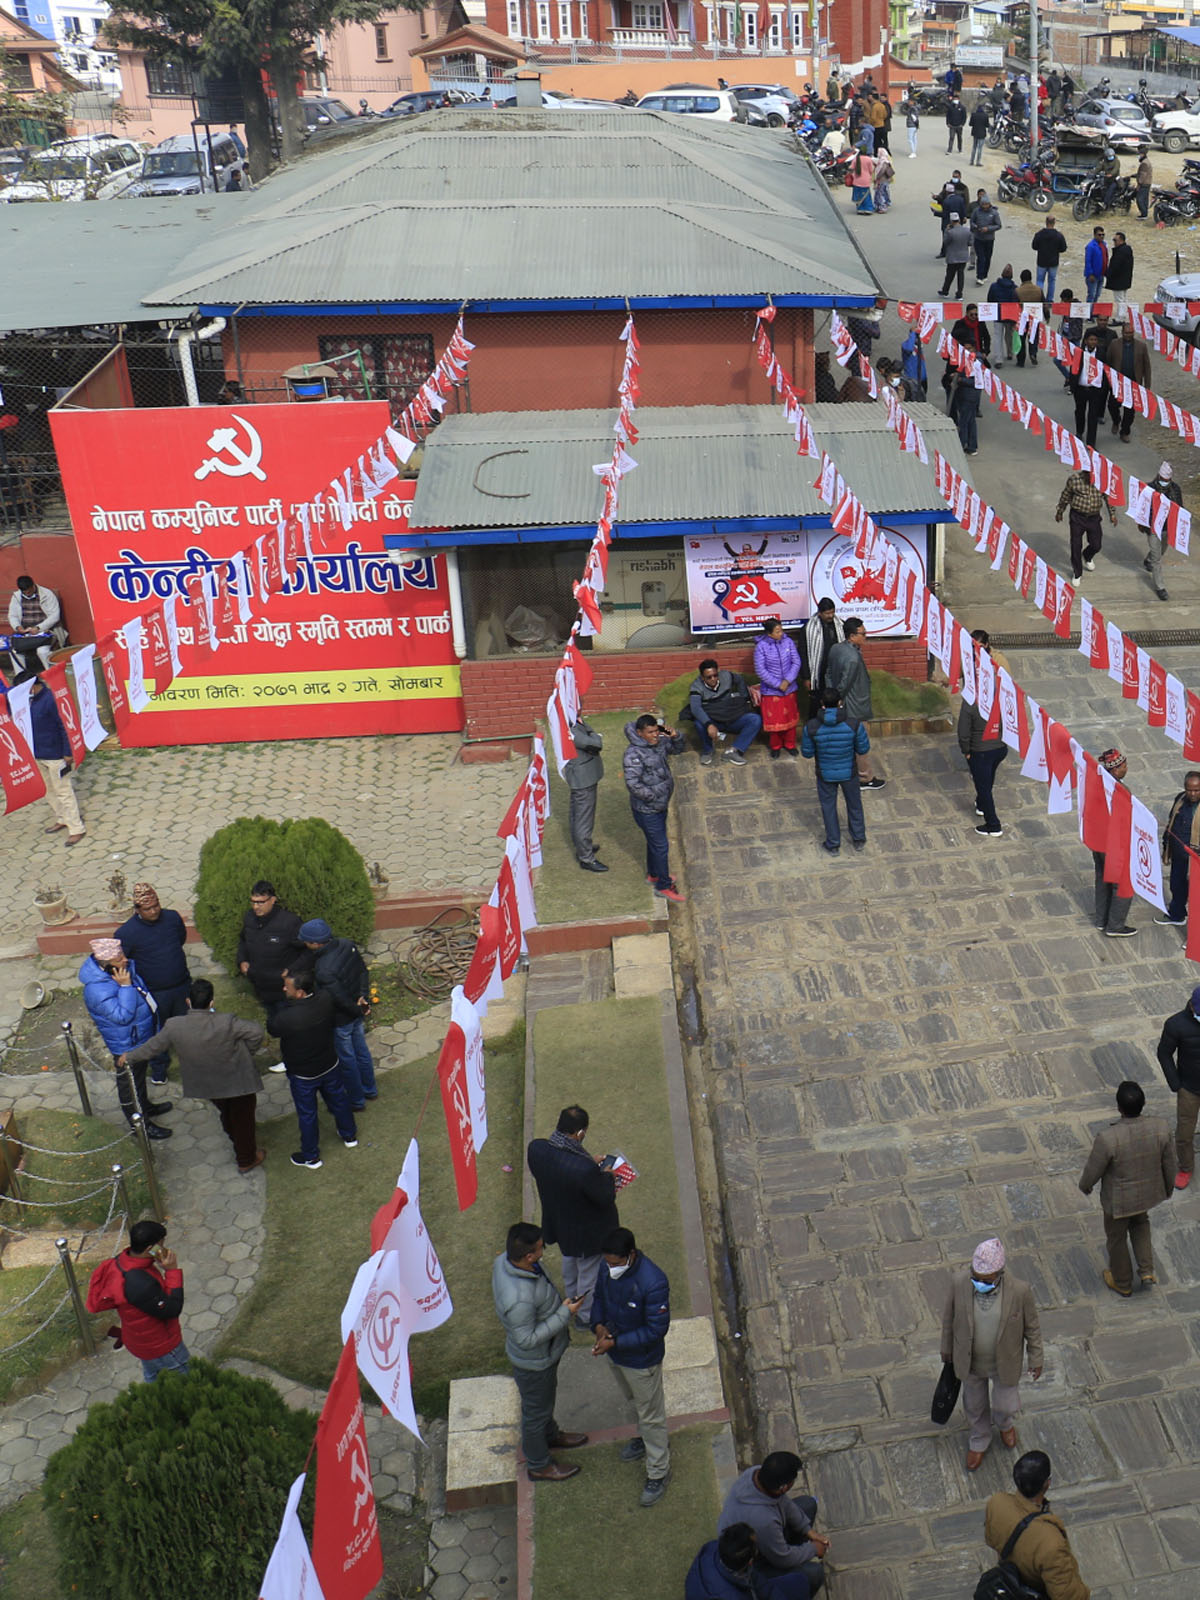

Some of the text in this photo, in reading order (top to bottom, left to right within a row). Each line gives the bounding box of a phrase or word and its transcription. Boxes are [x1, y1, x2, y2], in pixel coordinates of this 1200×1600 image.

[90, 505, 146, 532] नेपाल
[150, 500, 241, 534] कम्युनिष्ट
[244, 498, 284, 525] पार्टी
[253, 617, 292, 648] योद्धा
[296, 613, 340, 645] स्मृति
[345, 616, 393, 641] स्तम्भ
[397, 616, 411, 638] र
[415, 611, 451, 635] पार्क
[253, 684, 298, 698] २०७१
[303, 680, 331, 696] भाद्र
[336, 682, 347, 693] २
[388, 675, 444, 692] सोमबार
